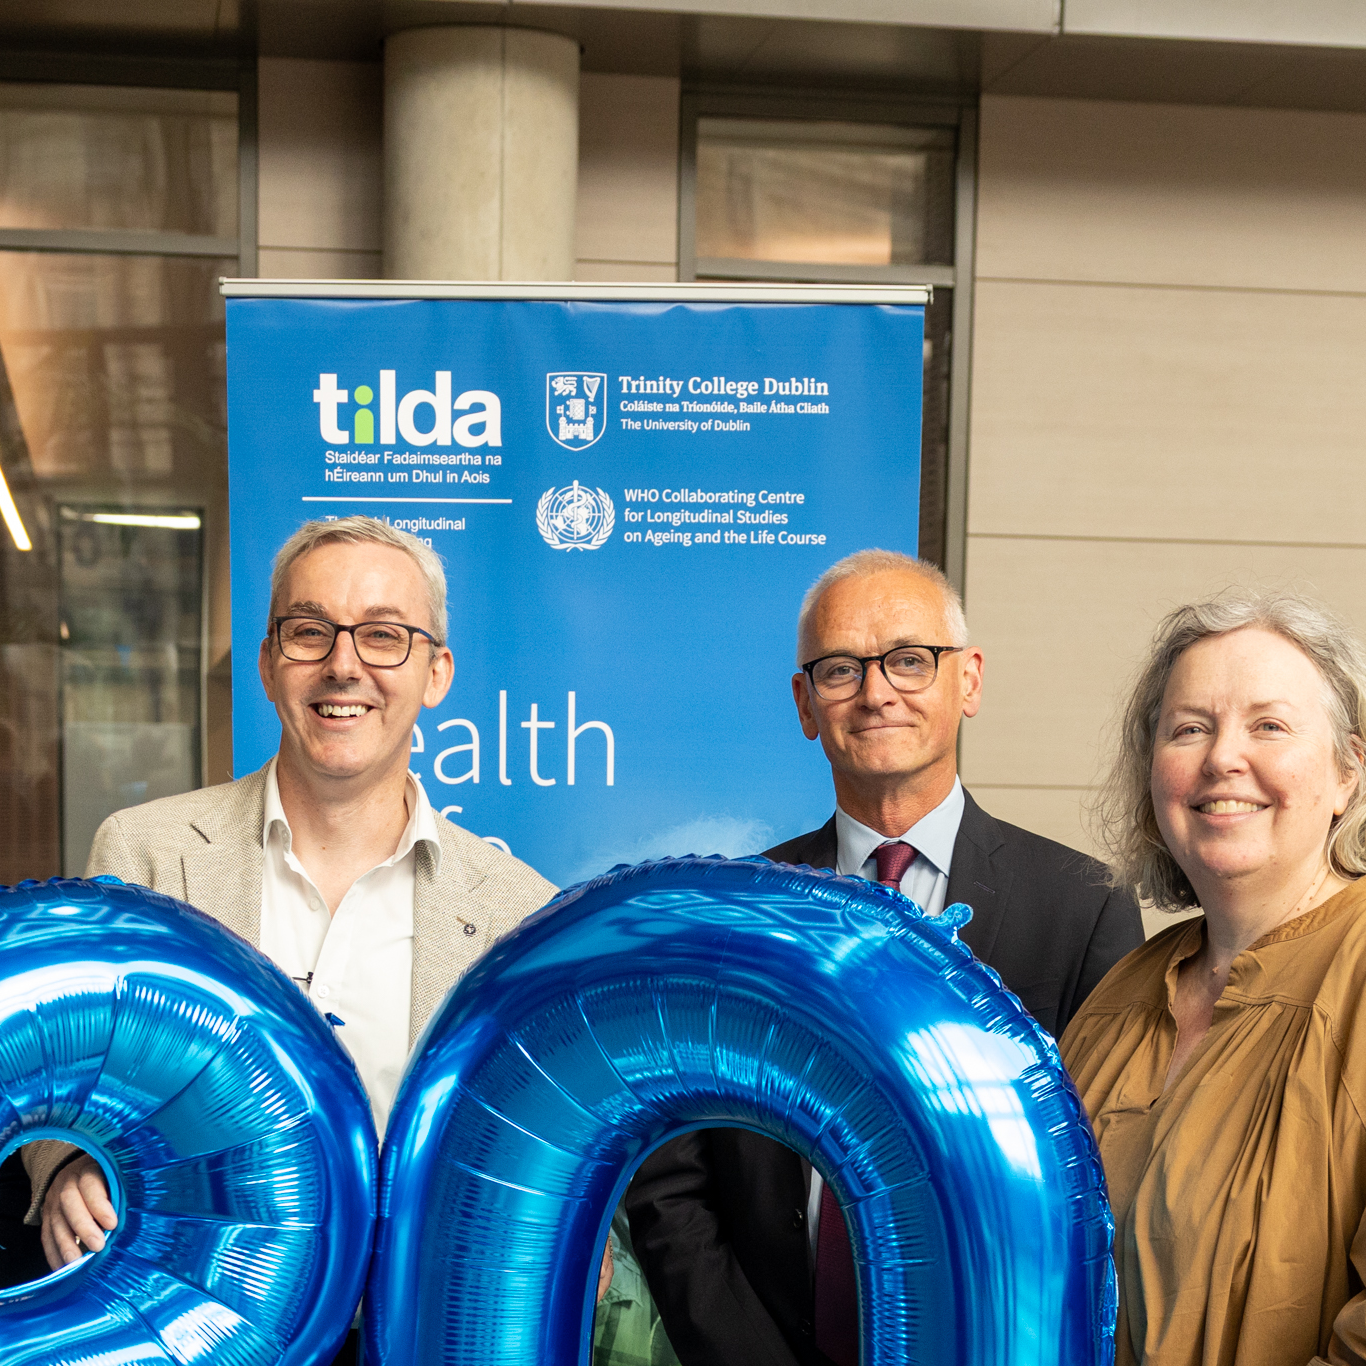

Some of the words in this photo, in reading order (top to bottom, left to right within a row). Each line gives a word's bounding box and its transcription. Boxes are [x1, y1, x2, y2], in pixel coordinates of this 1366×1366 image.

[619, 375, 684, 398] Trinity
[688, 376, 759, 399] College
[764, 377, 830, 396] Dublin
[313, 369, 502, 448] tilda
[620, 400, 664, 413] Coláiste
[666, 404, 680, 413] na
[681, 401, 738, 415] Tríonóide,
[739, 402, 768, 414] Baile
[769, 400, 794, 414] Átha
[796, 402, 830, 414] Cliath
[620, 418, 642, 431] The
[644, 419, 699, 434] University
[700, 419, 713, 431] of
[714, 420, 751, 432] Dublin
[325, 450, 381, 465] Staidéar
[384, 451, 482, 466] Fadaimseartha
[485, 455, 502, 466] na
[325, 466, 384, 483] hÉireann
[388, 472, 408, 483] um
[412, 470, 443, 484] Dhul
[447, 470, 458, 484] in
[461, 470, 490, 484] Aois
[624, 489, 660, 503] WHO
[662, 489, 756, 508] Collaborating
[758, 490, 806, 504] Centre
[387, 516, 466, 532] Longitudinal
[624, 508, 645, 522] for
[647, 509, 734, 526] Longitudinal
[737, 510, 789, 525] Studies
[624, 532, 642, 543] on
[645, 529, 692, 547] Ageing
[694, 530, 721, 544] and
[724, 530, 748, 545] the
[750, 530, 776, 545] Life
[778, 531, 827, 545] Course
